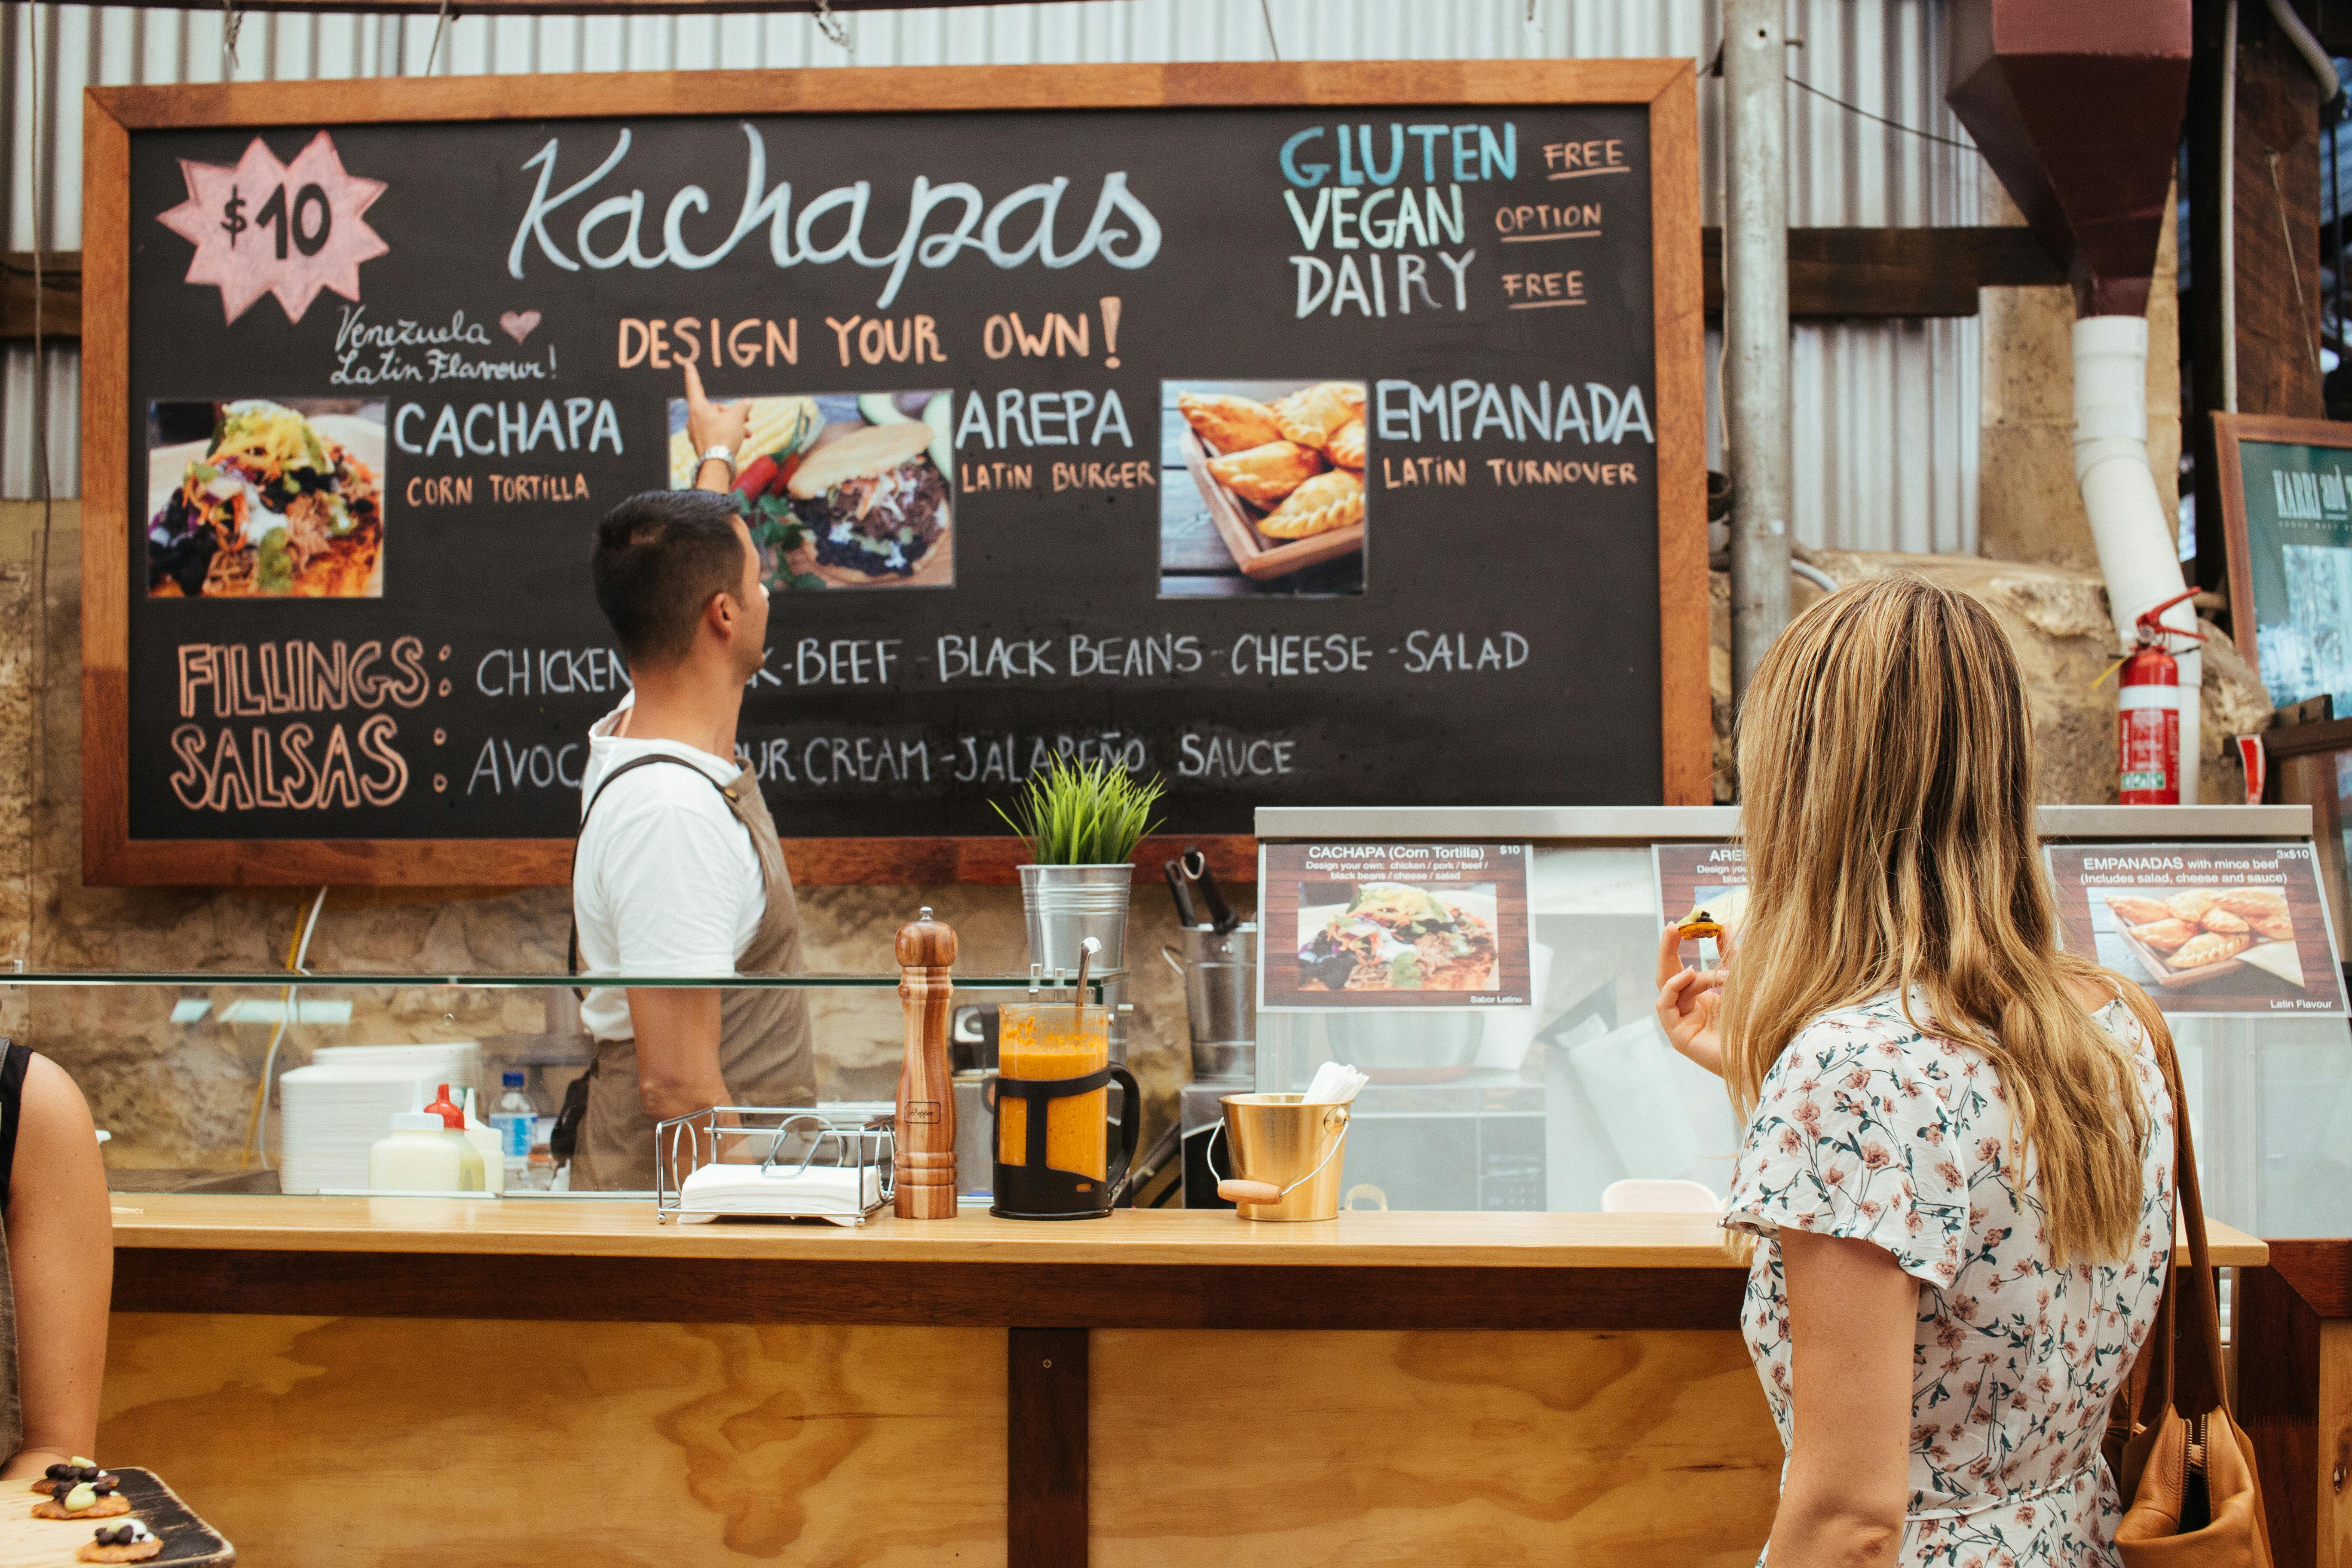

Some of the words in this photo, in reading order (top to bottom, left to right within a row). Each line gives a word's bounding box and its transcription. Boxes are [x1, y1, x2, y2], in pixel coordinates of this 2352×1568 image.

[1279, 122, 1517, 187] GLUTEN
[1543, 139, 1623, 169] FREE
[221, 182, 331, 260] $10
[508, 123, 1162, 309] Kachapas
[1283, 183, 1466, 251] VEGAN
[1495, 203, 1602, 233] OPTION
[1289, 248, 1476, 318] DAIRY
[1500, 270, 1583, 298] FREE
[336, 304, 491, 352] Venezuela
[619, 316, 798, 368] DESIGN
[825, 313, 947, 368] YOUR
[984, 296, 1123, 369] OWN!
[331, 349, 422, 384] Latin
[394, 397, 624, 458] CACHAPA
[955, 388, 1133, 449] AREPA
[1375, 378, 1655, 444] EMPANADA
[1053, 461, 1157, 492] BURGER
[1486, 458, 1638, 486] TURNOVER
[405, 475, 473, 507] CORN
[1071, 634, 1201, 678] BEANS
[467, 736, 582, 796] AVOC
[805, 737, 931, 785] CREAM
[1178, 732, 1295, 778] SAUCE
[1305, 861, 1338, 871] Design
[1341, 863, 1361, 871] your
[1390, 861, 1426, 870] chicken
[1433, 861, 1454, 871] pork
[1461, 861, 1482, 870] beef
[1309, 846, 1386, 858] CACHAPA
[1389, 846, 1429, 860] (Corn
[1432, 846, 1485, 861] Tortilla)
[1499, 845, 1520, 854] $10
[1709, 849, 1747, 862] ARE
[2083, 857, 2184, 870] EMPANADAS
[2187, 859, 2211, 869] with
[2214, 859, 2250, 869] mince
[2252, 859, 2278, 869] beef
[2276, 849, 2309, 860] 3x$10
[1435, 872, 1461, 880] salad
[1697, 865, 1729, 875] Design
[2080, 873, 2135, 885] (Includes
[2137, 873, 2173, 884] salad,
[2175, 873, 2218, 883] cheese
[2222, 873, 2244, 883] and
[2247, 872, 2287, 885] sauce)
[2270, 999, 2294, 1008] Latin
[2296, 999, 2332, 1008] Flavour
